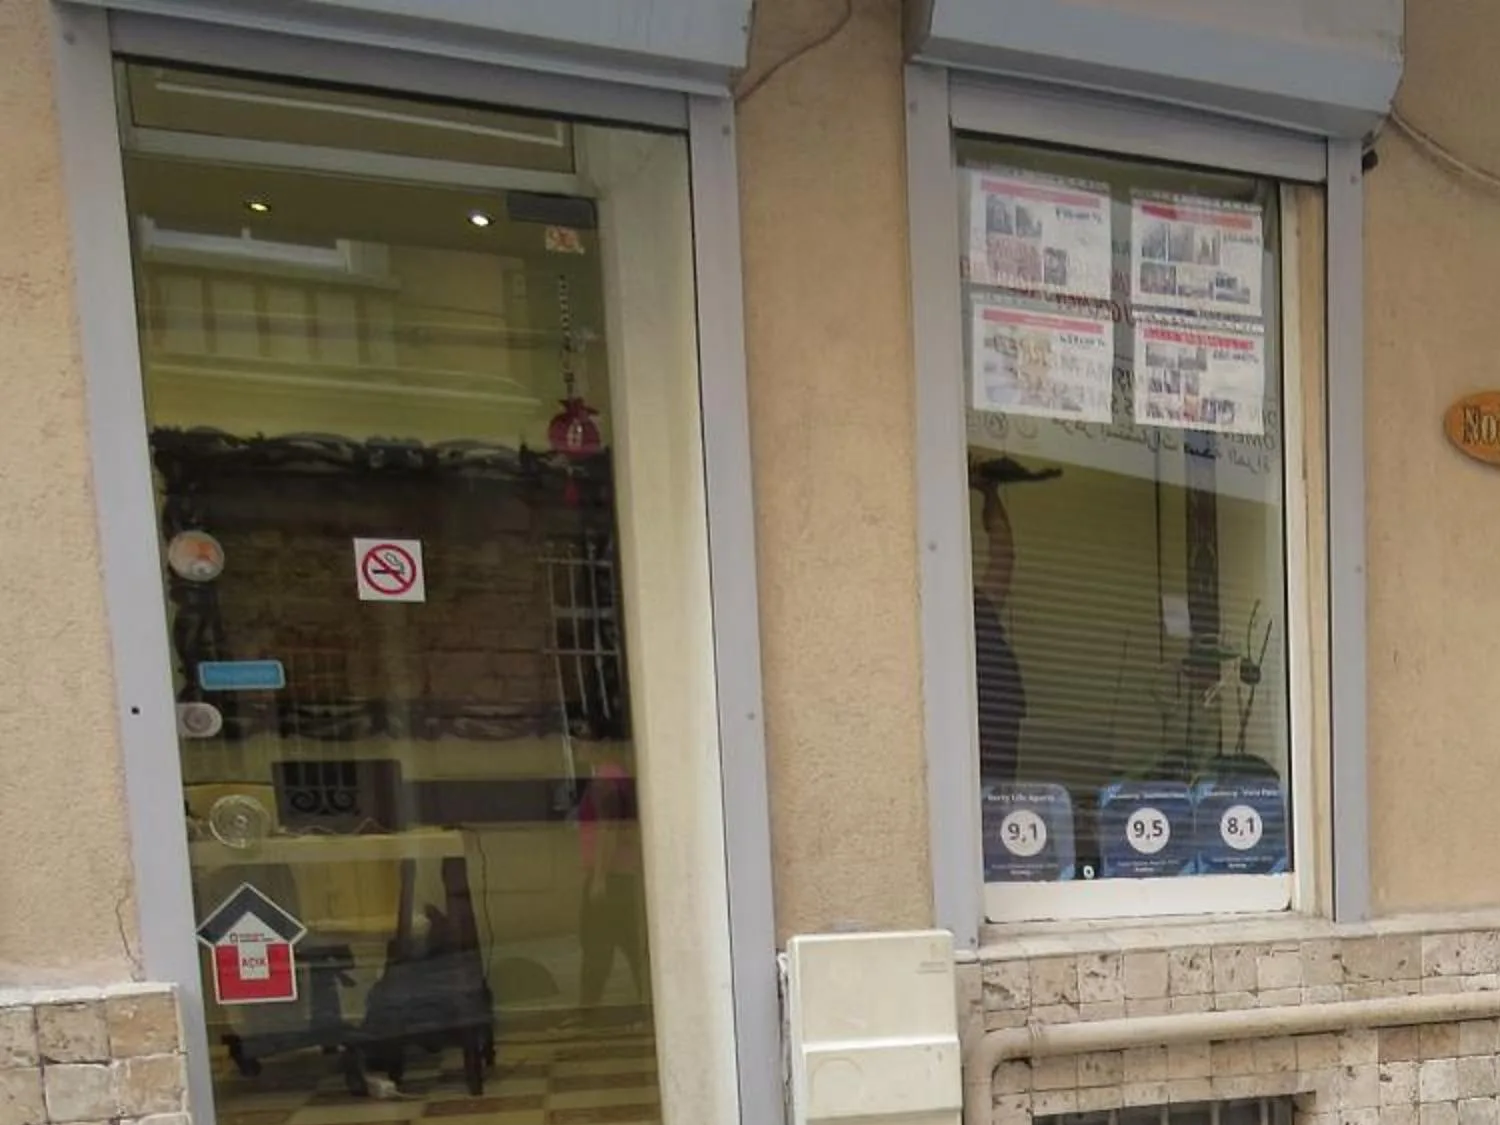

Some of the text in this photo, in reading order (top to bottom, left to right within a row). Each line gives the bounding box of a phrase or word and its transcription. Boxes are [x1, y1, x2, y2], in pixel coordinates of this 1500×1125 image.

[1008, 822, 1038, 843] 9,1
[1133, 819, 1163, 840] 9,5
[1227, 817, 1255, 837] 8,1
